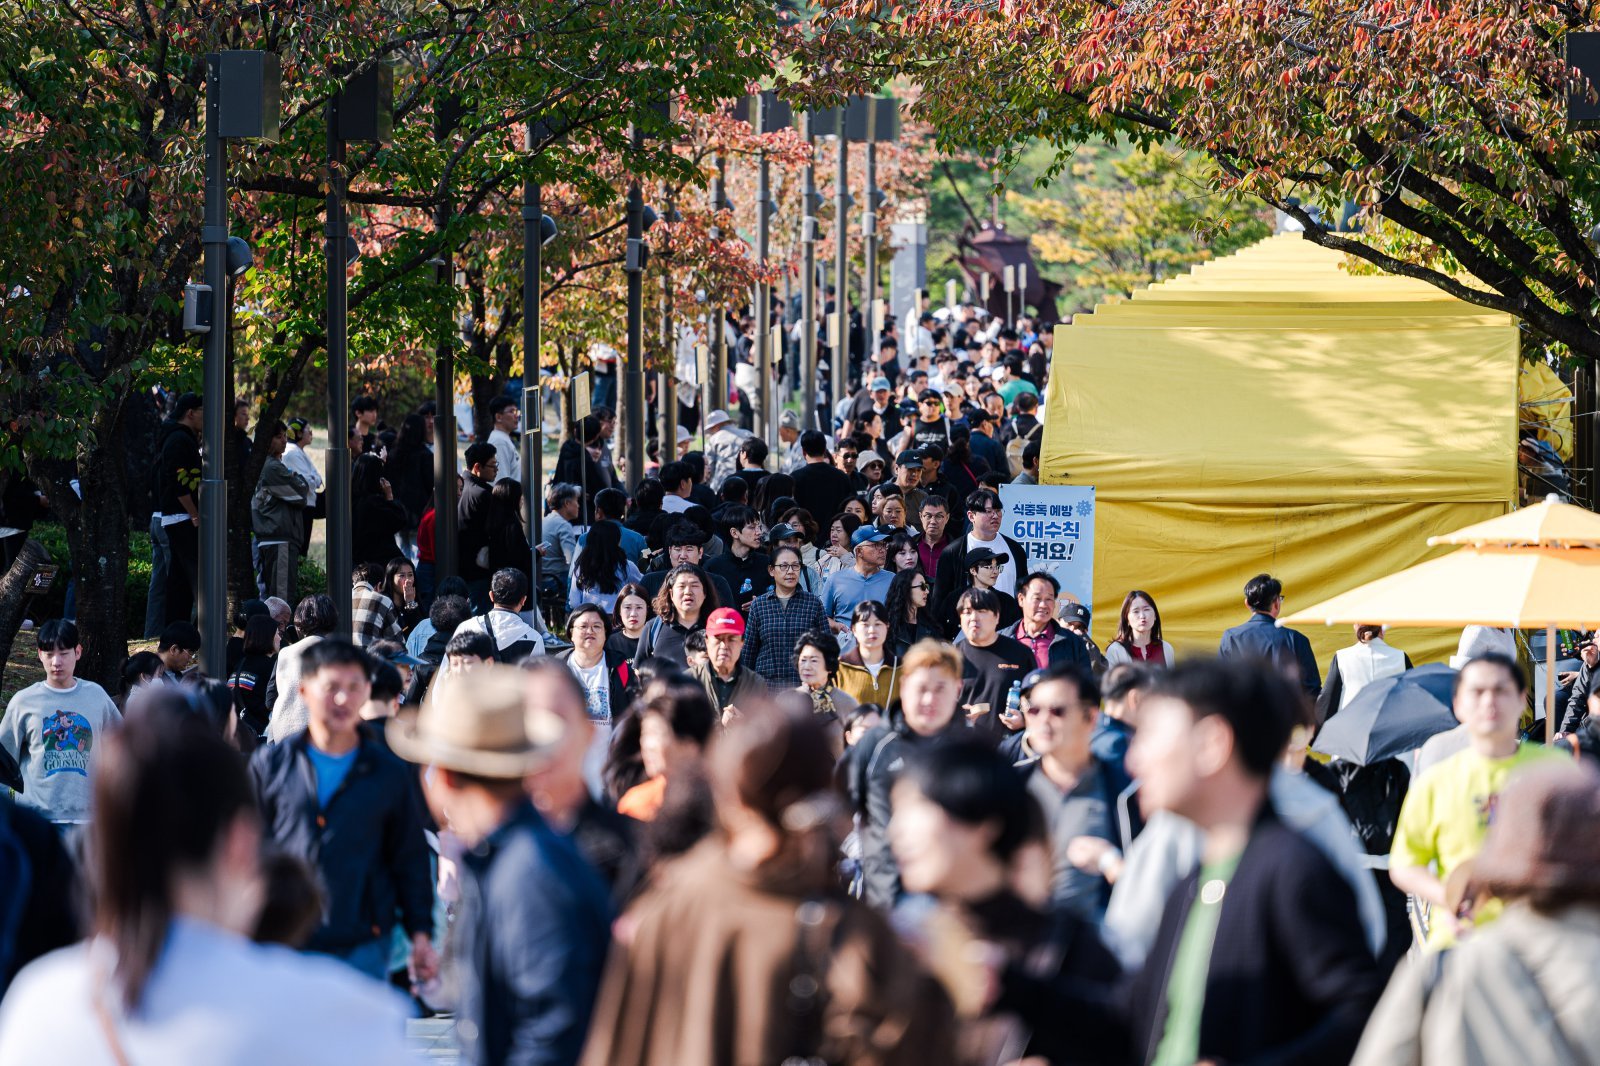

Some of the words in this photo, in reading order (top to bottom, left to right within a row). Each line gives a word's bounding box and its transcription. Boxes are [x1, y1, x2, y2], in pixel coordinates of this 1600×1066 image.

[1012, 503, 1047, 517] 식중독
[1049, 504, 1073, 517] 예방
[1013, 520, 1080, 540] 6대수칙
